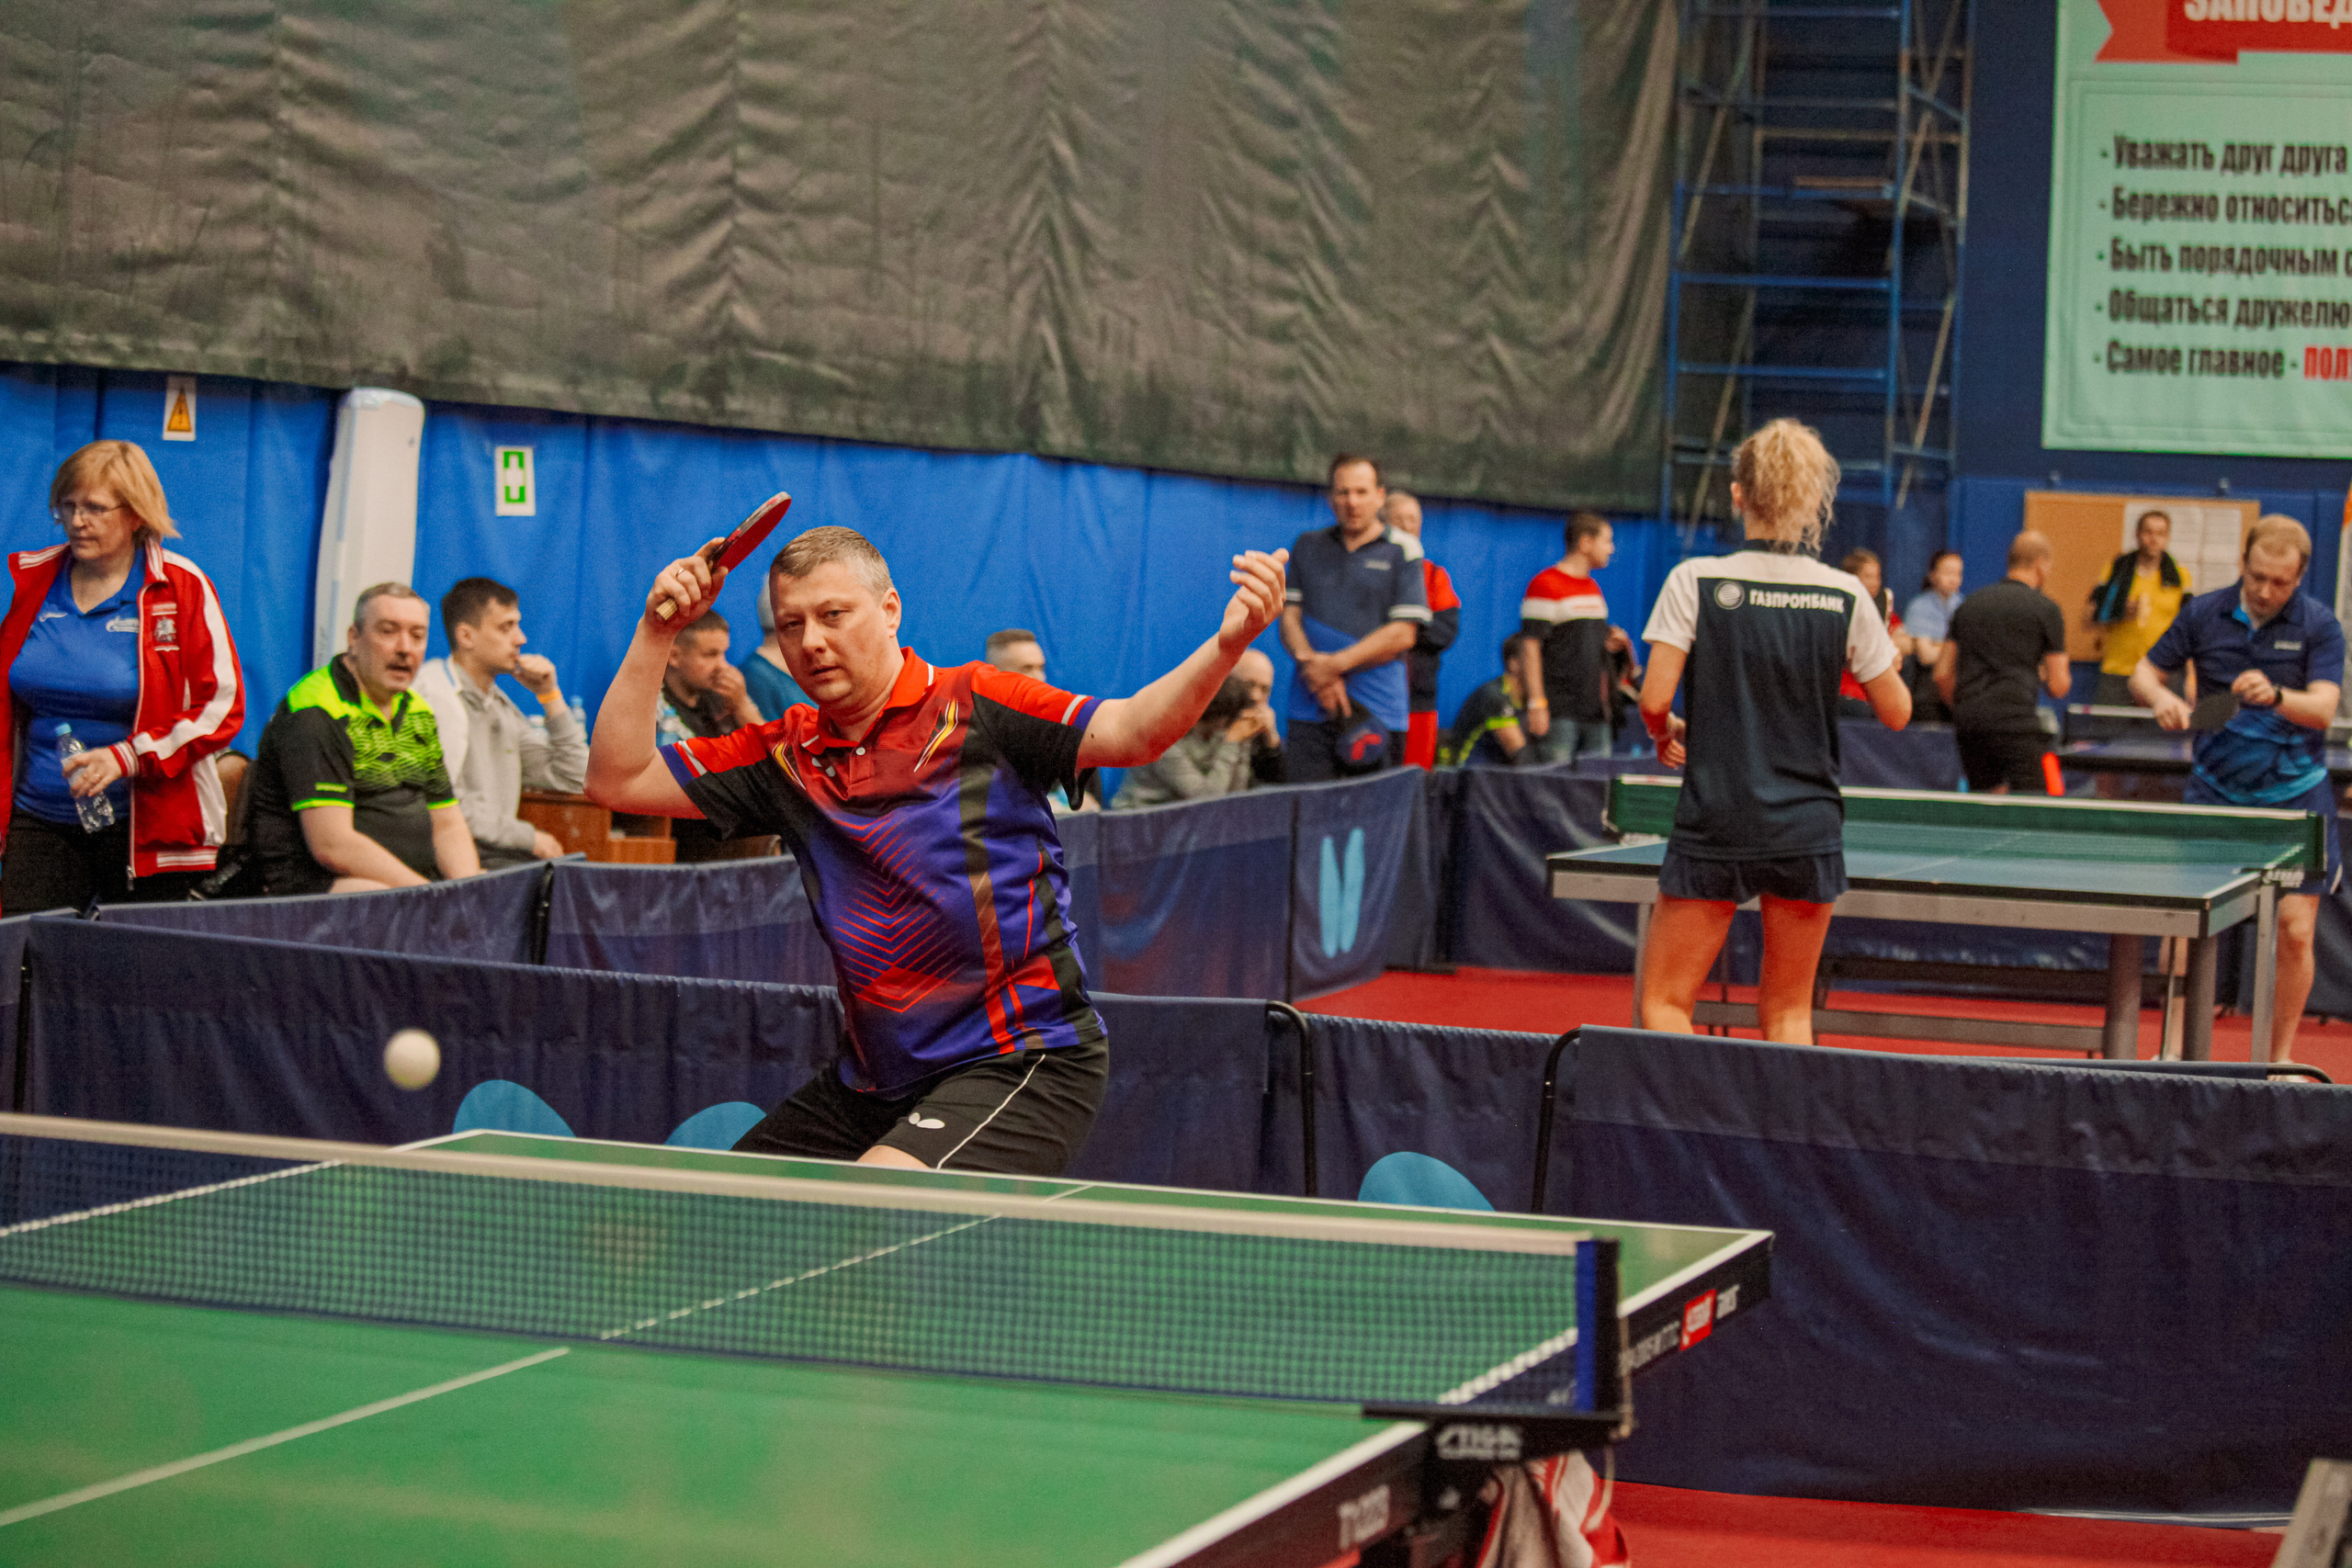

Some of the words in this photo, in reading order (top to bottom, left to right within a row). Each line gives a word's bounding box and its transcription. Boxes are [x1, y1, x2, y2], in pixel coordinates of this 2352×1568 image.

[2114, 135, 2214, 170] Уважать
[2221, 142, 2274, 175] друг
[2279, 143, 2347, 176] друга
[2112, 186, 2219, 222] Бережно
[2111, 237, 2172, 272] Быть
[2180, 243, 2338, 278] порядочным
[2109, 289, 2228, 325] Общаться
[2108, 340, 2182, 377] Самое
[2188, 346, 2284, 379] главное
[2303, 344, 2352, 382] ПОЛ
[1749, 589, 1845, 613] ГАЗПРОМБАНК
